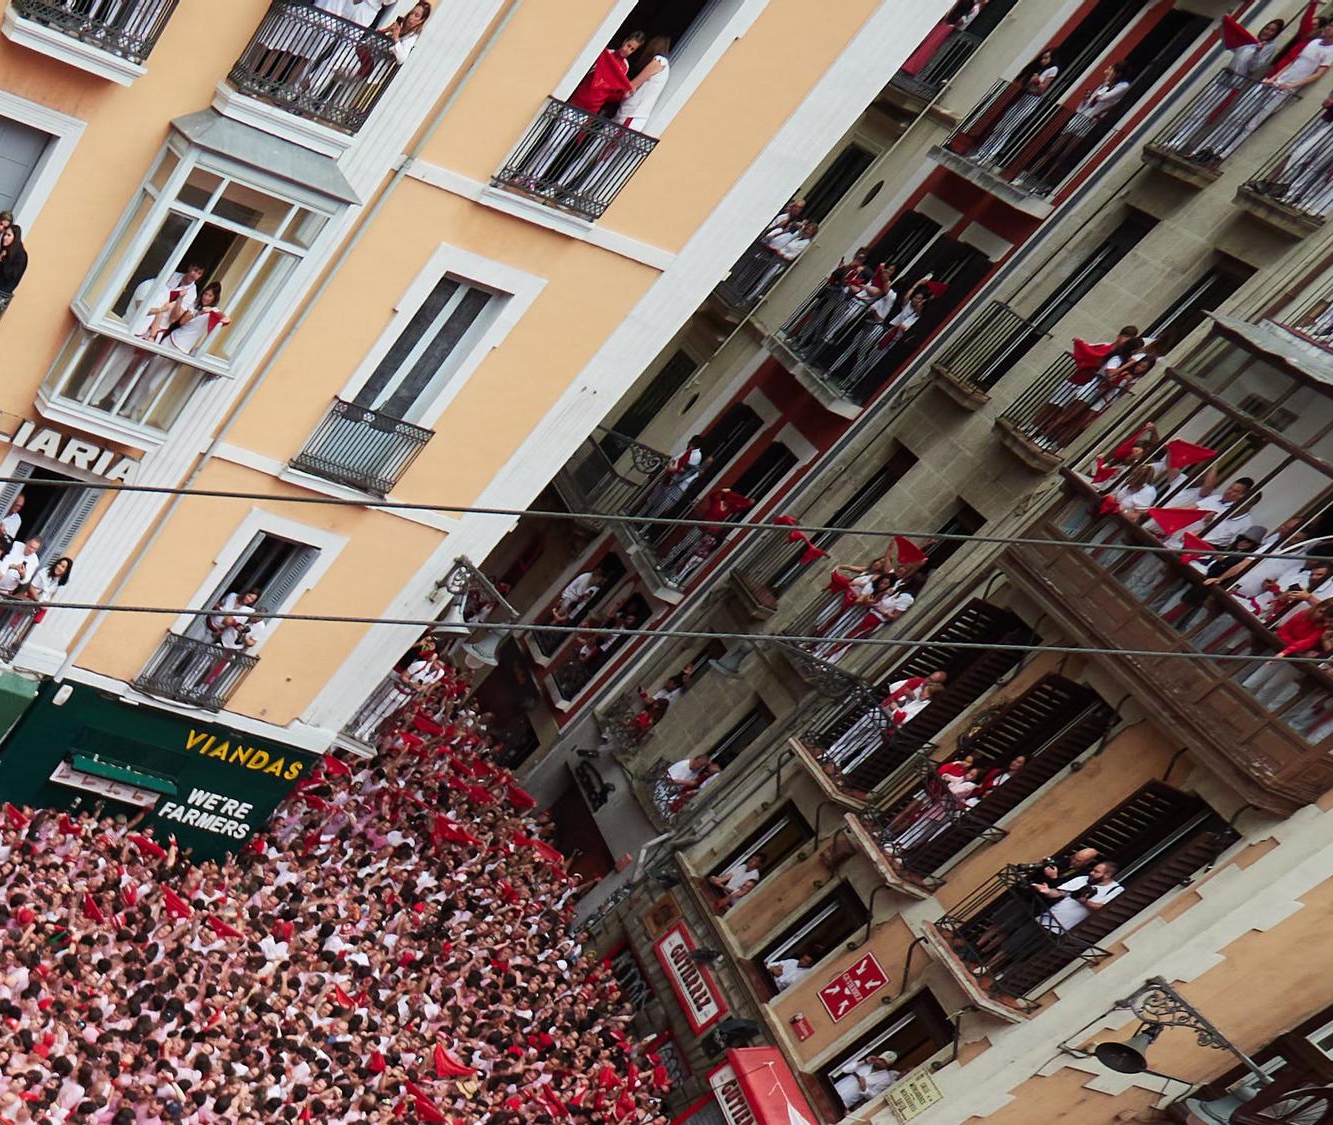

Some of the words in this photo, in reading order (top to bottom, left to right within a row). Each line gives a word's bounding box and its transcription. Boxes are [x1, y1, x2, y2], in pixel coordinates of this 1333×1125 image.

[184, 729, 304, 781] VIANDAS
[157, 801, 251, 840] FARMERS
[187, 787, 254, 820] WE'RE
[670, 943, 712, 1013] GUTIERREZ
